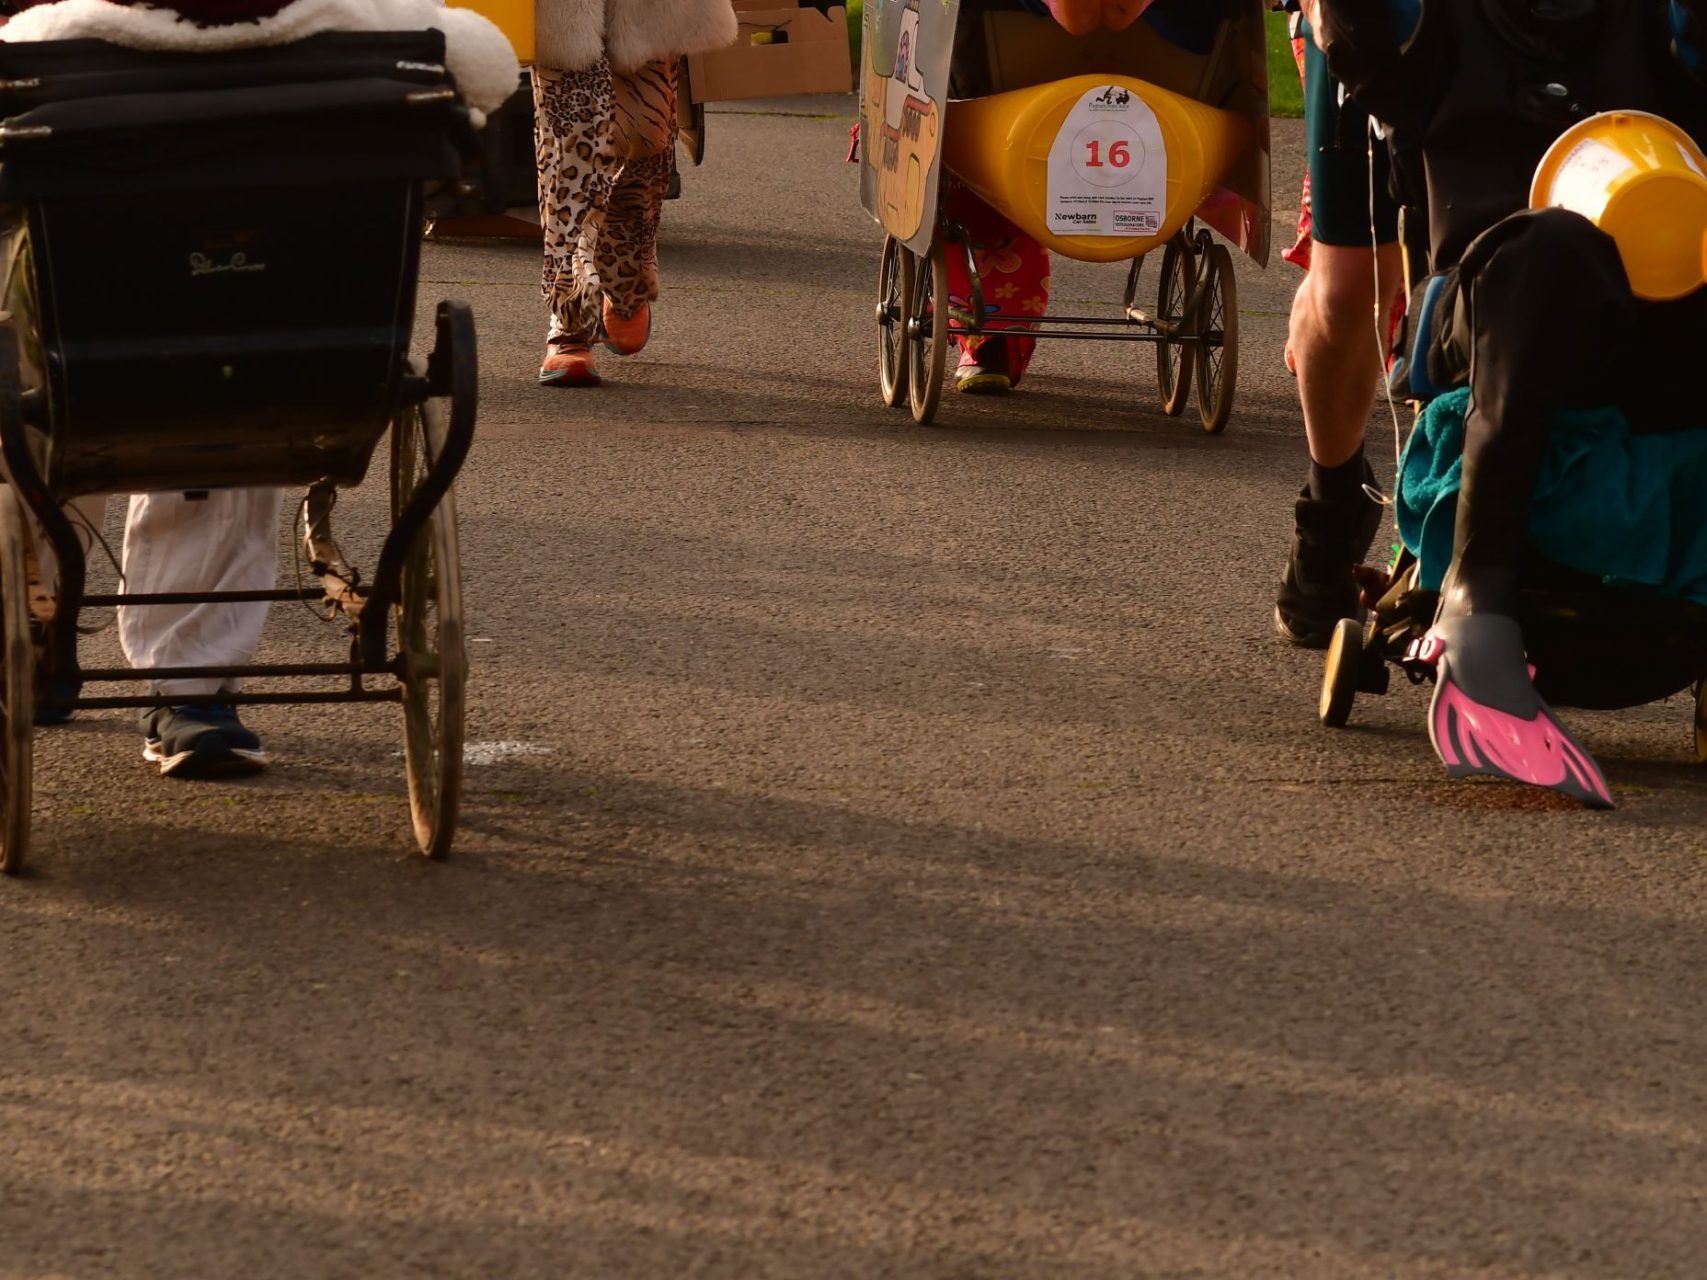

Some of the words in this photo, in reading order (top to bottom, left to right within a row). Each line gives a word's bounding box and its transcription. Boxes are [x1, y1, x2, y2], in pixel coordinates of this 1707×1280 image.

[1085, 140, 1130, 168] 16
[1054, 212, 1097, 221] Newbarn
[1115, 214, 1145, 223] OSBORNE
